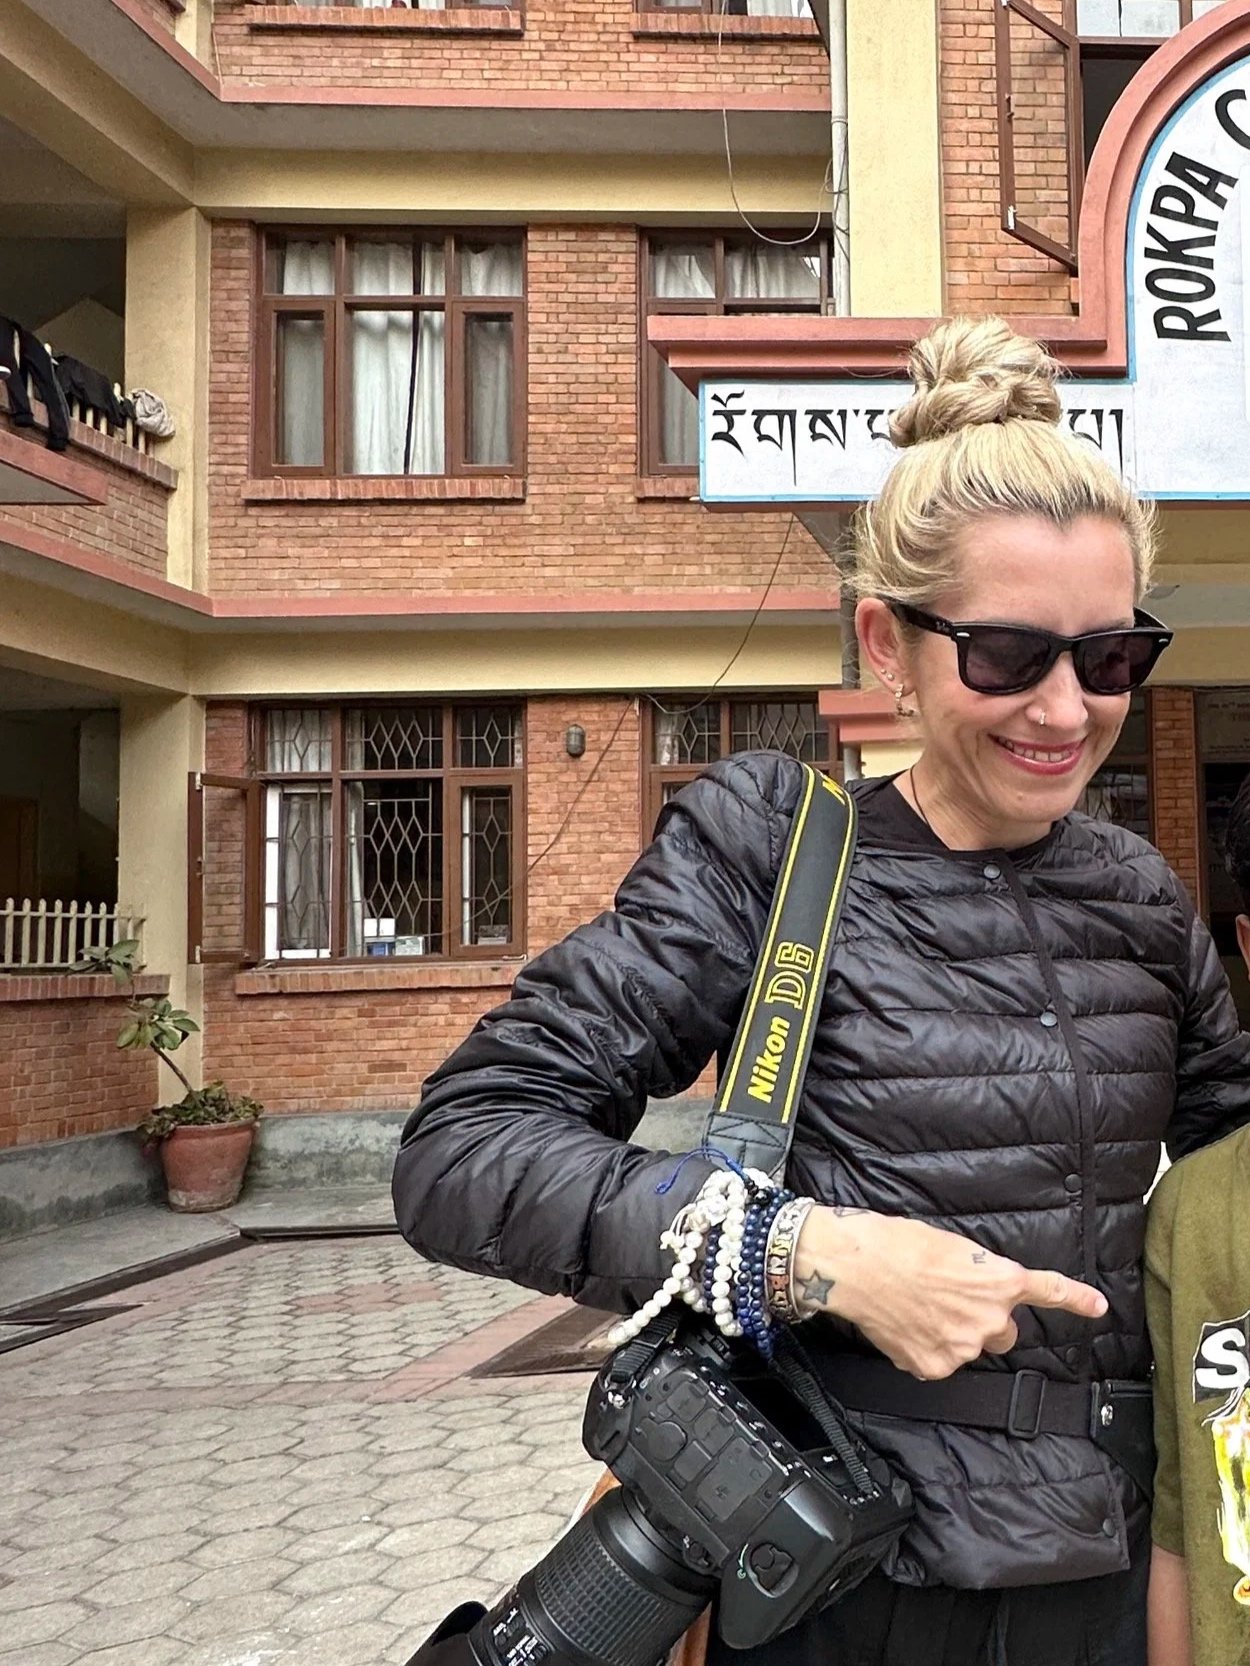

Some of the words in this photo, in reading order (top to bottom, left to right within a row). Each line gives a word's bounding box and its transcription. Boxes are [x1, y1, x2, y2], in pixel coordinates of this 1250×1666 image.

[1143, 151, 1239, 343] ROKPA
[764, 941, 815, 1010] D6
[747, 1015, 791, 1104] Nikon
